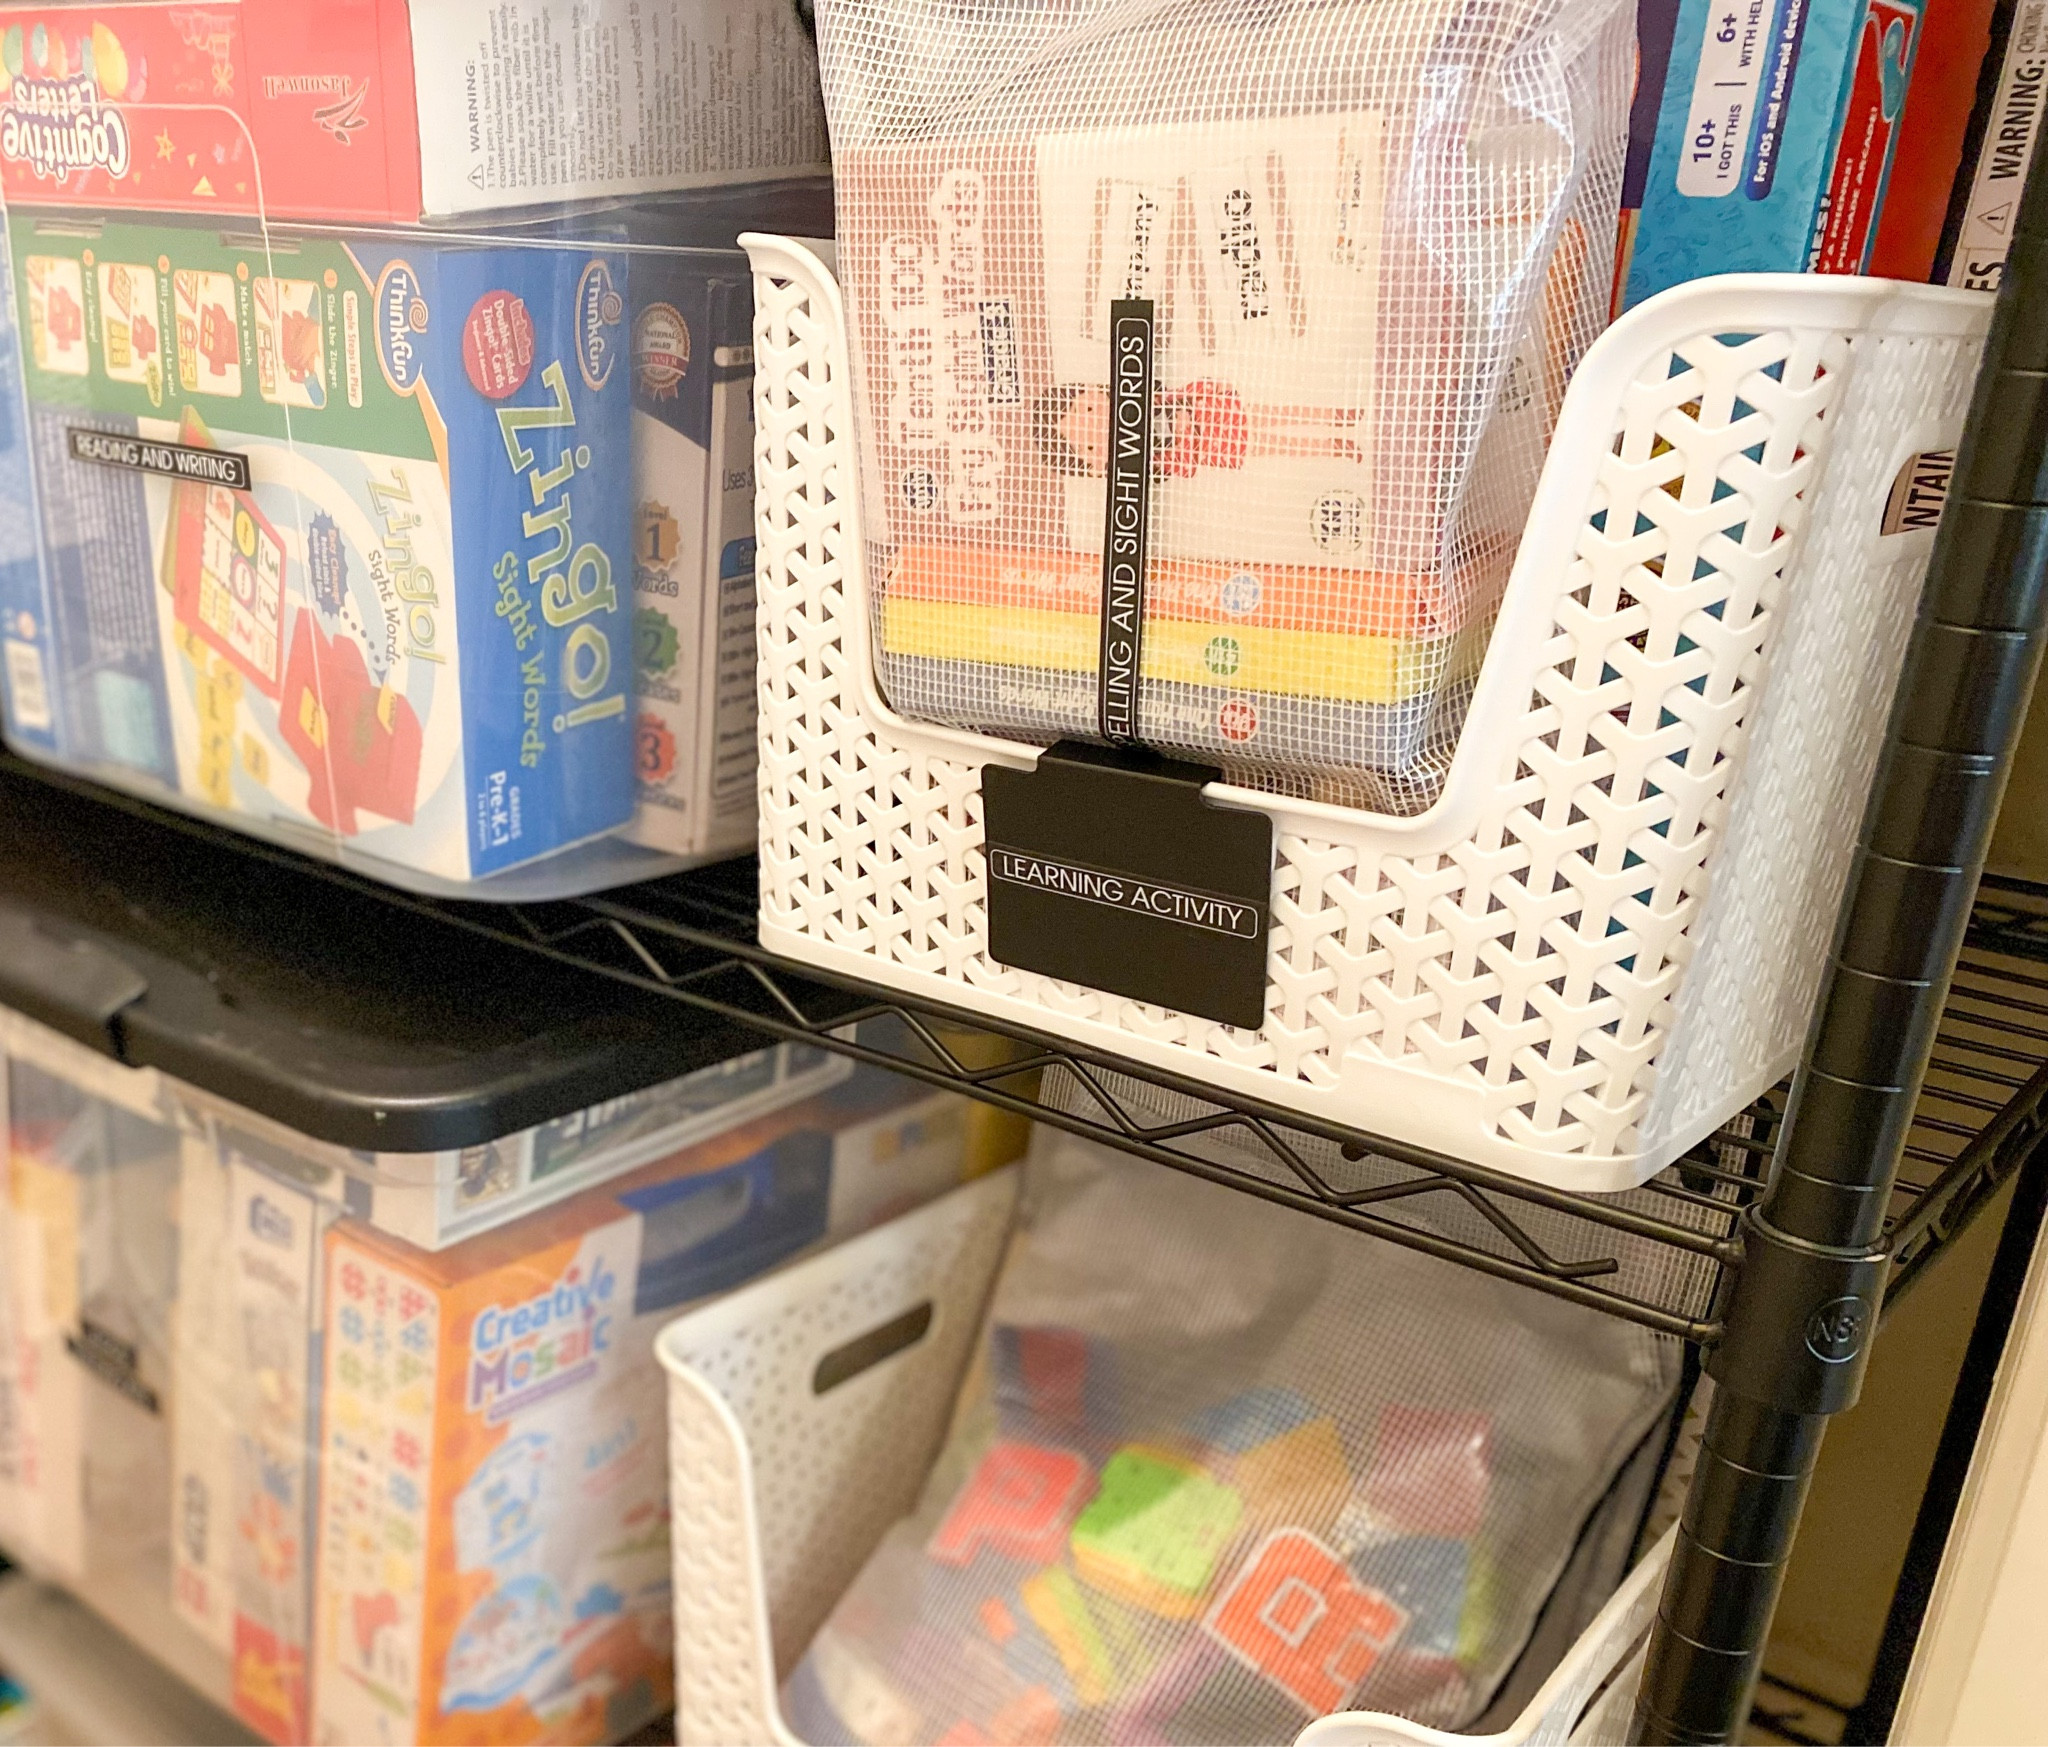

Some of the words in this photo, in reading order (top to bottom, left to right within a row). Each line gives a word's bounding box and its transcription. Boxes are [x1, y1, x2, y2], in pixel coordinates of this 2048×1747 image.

[1717, 13, 1736, 43] 6+
[1739, 29, 1757, 67] WITH
[1748, 0, 1762, 25] HEL
[263, 75, 351, 97] Jasonwell
[493, 63, 500, 76] to
[514, 80, 522, 100] the
[1771, 43, 1793, 100] Android
[15, 79, 97, 121] Letters
[465, 60, 480, 153] WARNING:
[483, 114, 492, 124] is
[1766, 103, 1781, 129] and
[485, 128, 495, 151] pen
[506, 113, 514, 143] from
[527, 131, 535, 148] for
[558, 116, 567, 139] you
[1693, 120, 1716, 163] 10+
[1725, 104, 1741, 138] THIS
[2, 108, 127, 181] Cognitive
[1719, 141, 1734, 170] GOT
[1757, 133, 1774, 157] iOS
[529, 152, 537, 186] water
[1754, 161, 1766, 182] For
[1965, 262, 2005, 290] ES
[1987, 59, 2046, 180] WARNING:
[941, 179, 979, 320] Words
[1221, 189, 1268, 320] radio
[889, 244, 924, 313] 100
[240, 285, 249, 317] Make
[326, 293, 336, 323] Slide
[159, 300, 170, 327] your
[165, 358, 174, 370] to
[328, 326, 337, 347] the
[346, 334, 357, 361] Steps
[348, 363, 357, 374] to
[490, 354, 504, 389] Cards
[943, 330, 985, 434] Sight
[1117, 335, 1144, 458] WORDS
[76, 435, 139, 465] READING
[141, 447, 173, 471] AND
[175, 453, 236, 482] WRITING
[723, 469, 746, 492] Uses
[1114, 466, 1140, 556] SIGHT
[496, 360, 626, 734] Zingo!
[647, 524, 664, 562] 1
[366, 468, 447, 665] Zingo!
[368, 549, 395, 602] Sight
[385, 607, 400, 665] Words
[1112, 564, 1136, 633] AND
[492, 551, 532, 652] Sight
[518, 655, 545, 769] Words
[640, 731, 660, 771] 3
[489, 770, 509, 846] Pre-K-1
[1002, 854, 1124, 902] LEARNING
[1130, 886, 1243, 930] ACTIVITY
[475, 1256, 614, 1350] Creative
[473, 1303, 612, 1406] Mosaic
